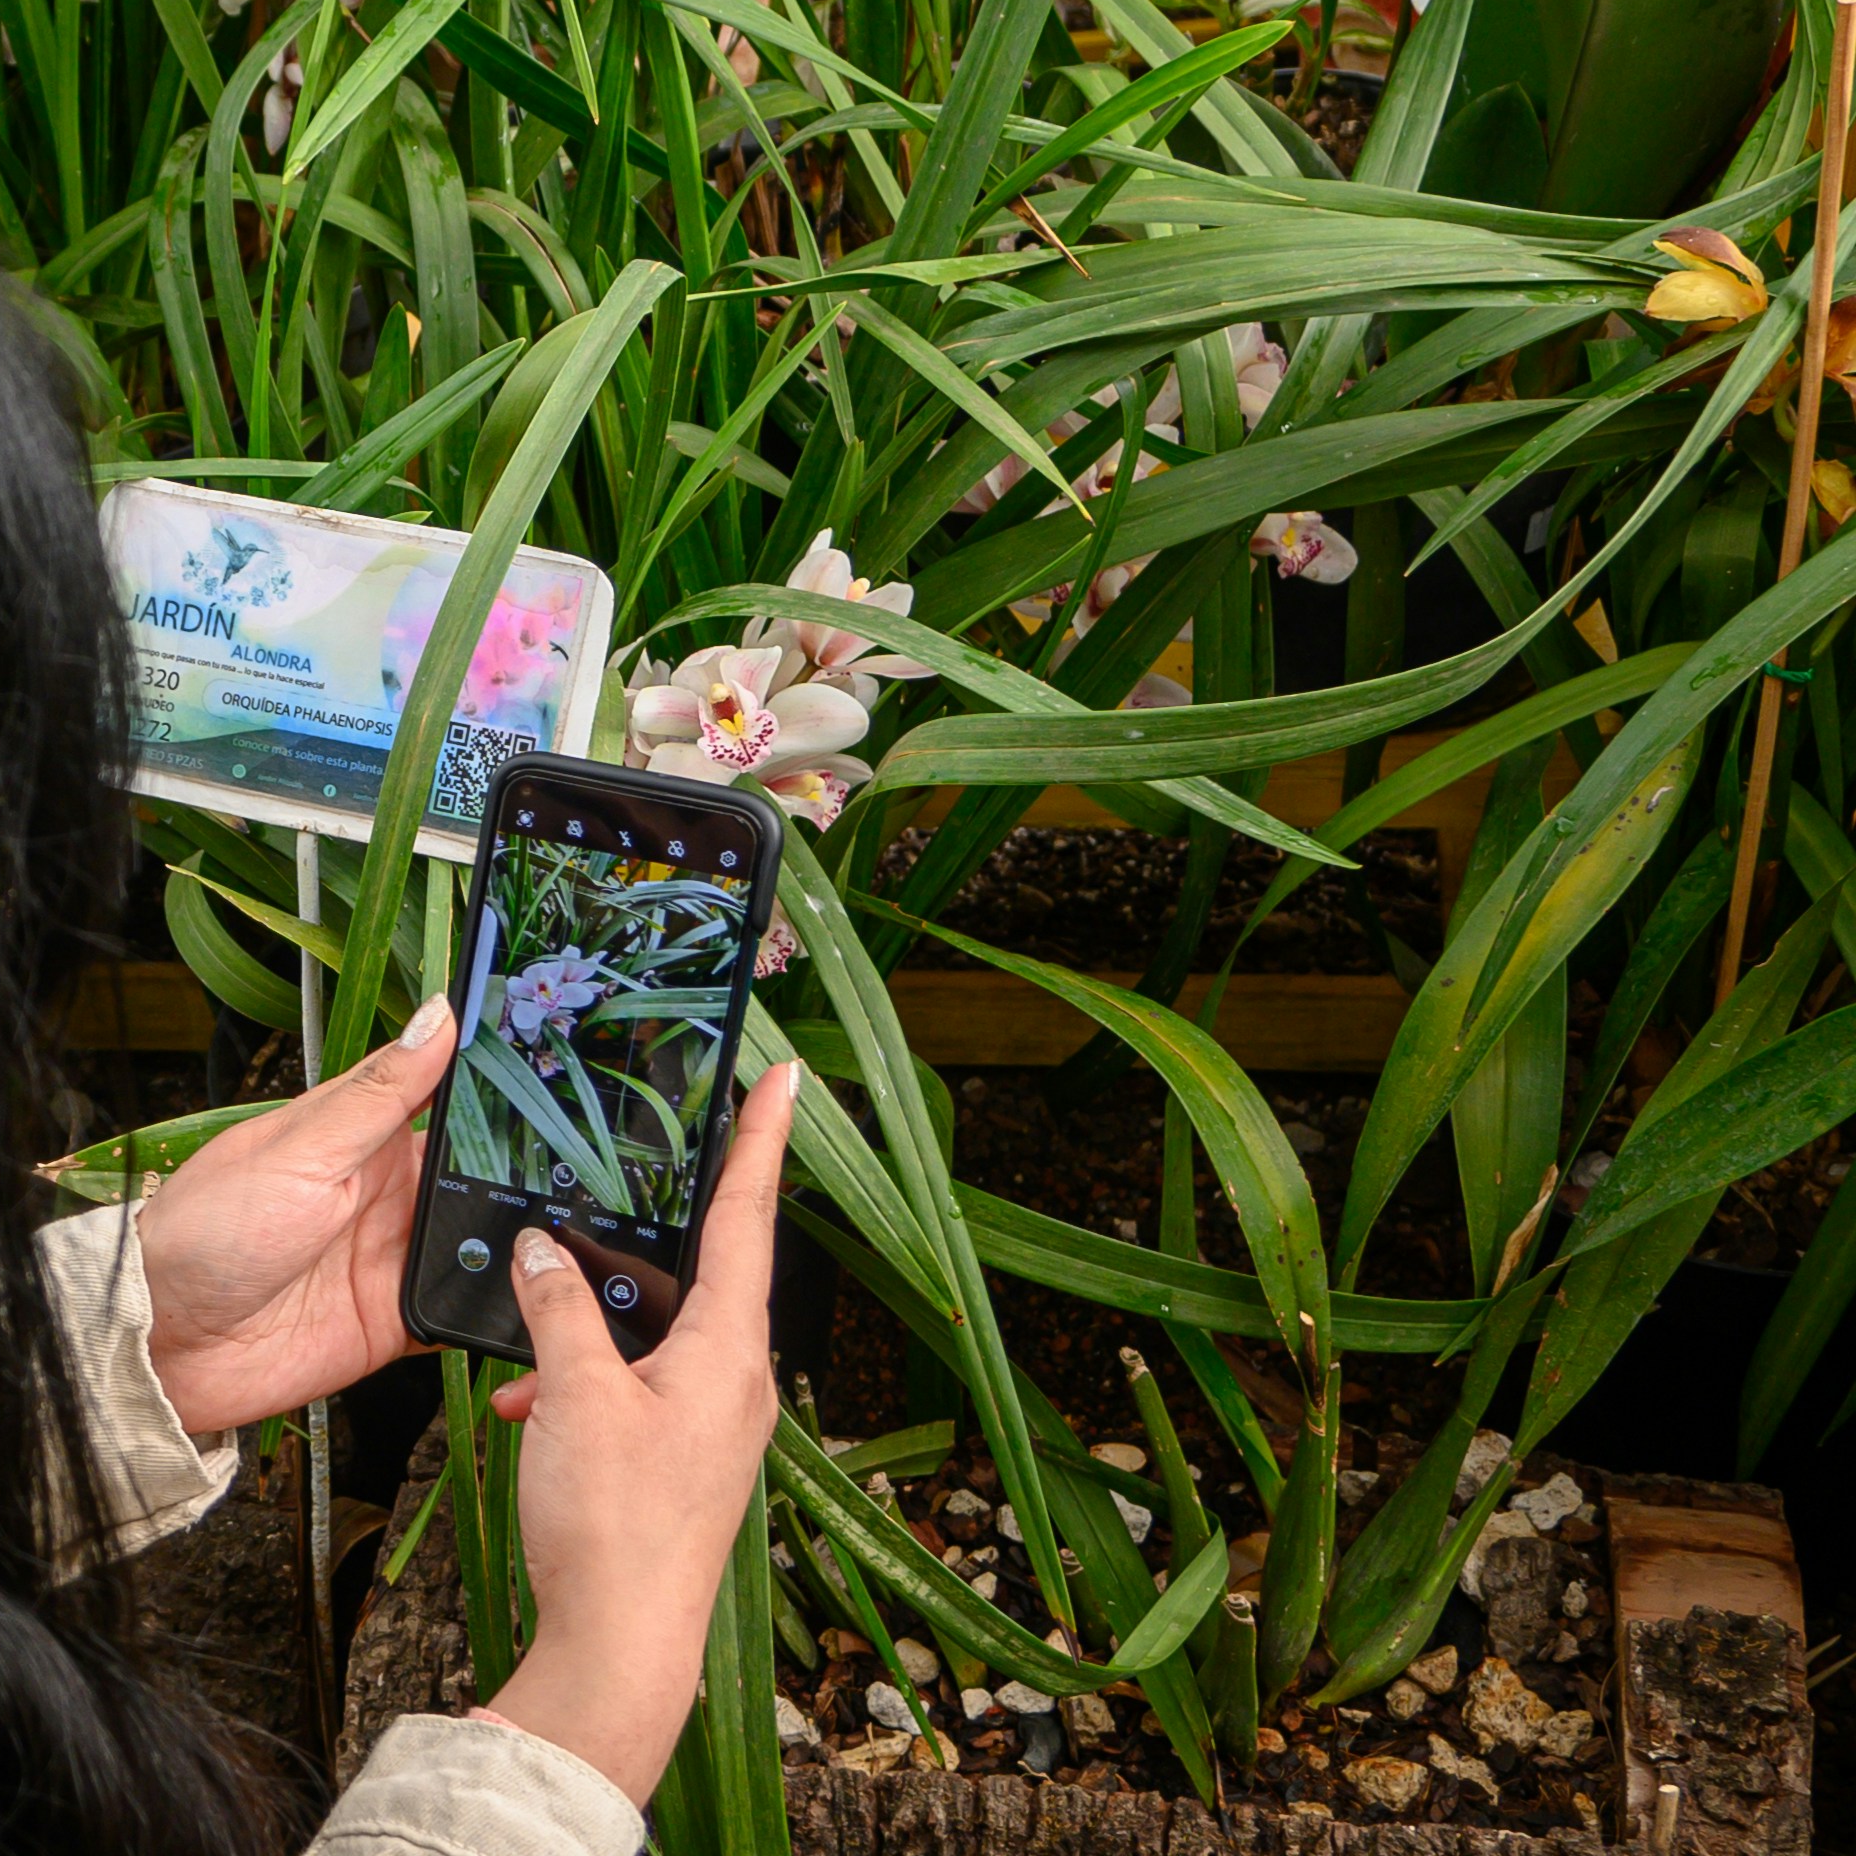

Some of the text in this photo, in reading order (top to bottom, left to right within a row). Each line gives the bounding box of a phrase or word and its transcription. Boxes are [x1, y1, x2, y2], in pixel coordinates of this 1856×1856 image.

[127, 593, 236, 640] JARDÍN
[142, 665, 180, 691] 320
[161, 651, 175, 661] que
[176, 654, 196, 665] pasas
[197, 658, 211, 668] con
[212, 660, 220, 669] tu
[221, 663, 237, 673] rosa
[244, 666, 252, 675] lo
[253, 669, 267, 679] que
[268, 671, 275, 680] la
[276, 672, 294, 684] hace
[295, 677, 325, 689] especial
[230, 644, 312, 674] ALONDRA
[222, 691, 393, 737] ORQUÍDEA PHALAENOPSIS
[232, 736, 270, 753] conoce
[295, 749, 324, 764] sobre
[326, 755, 348, 769] esta
[439, 1178, 657, 1240] NOCHE RETRATO FOTO VIDEO MÁS
